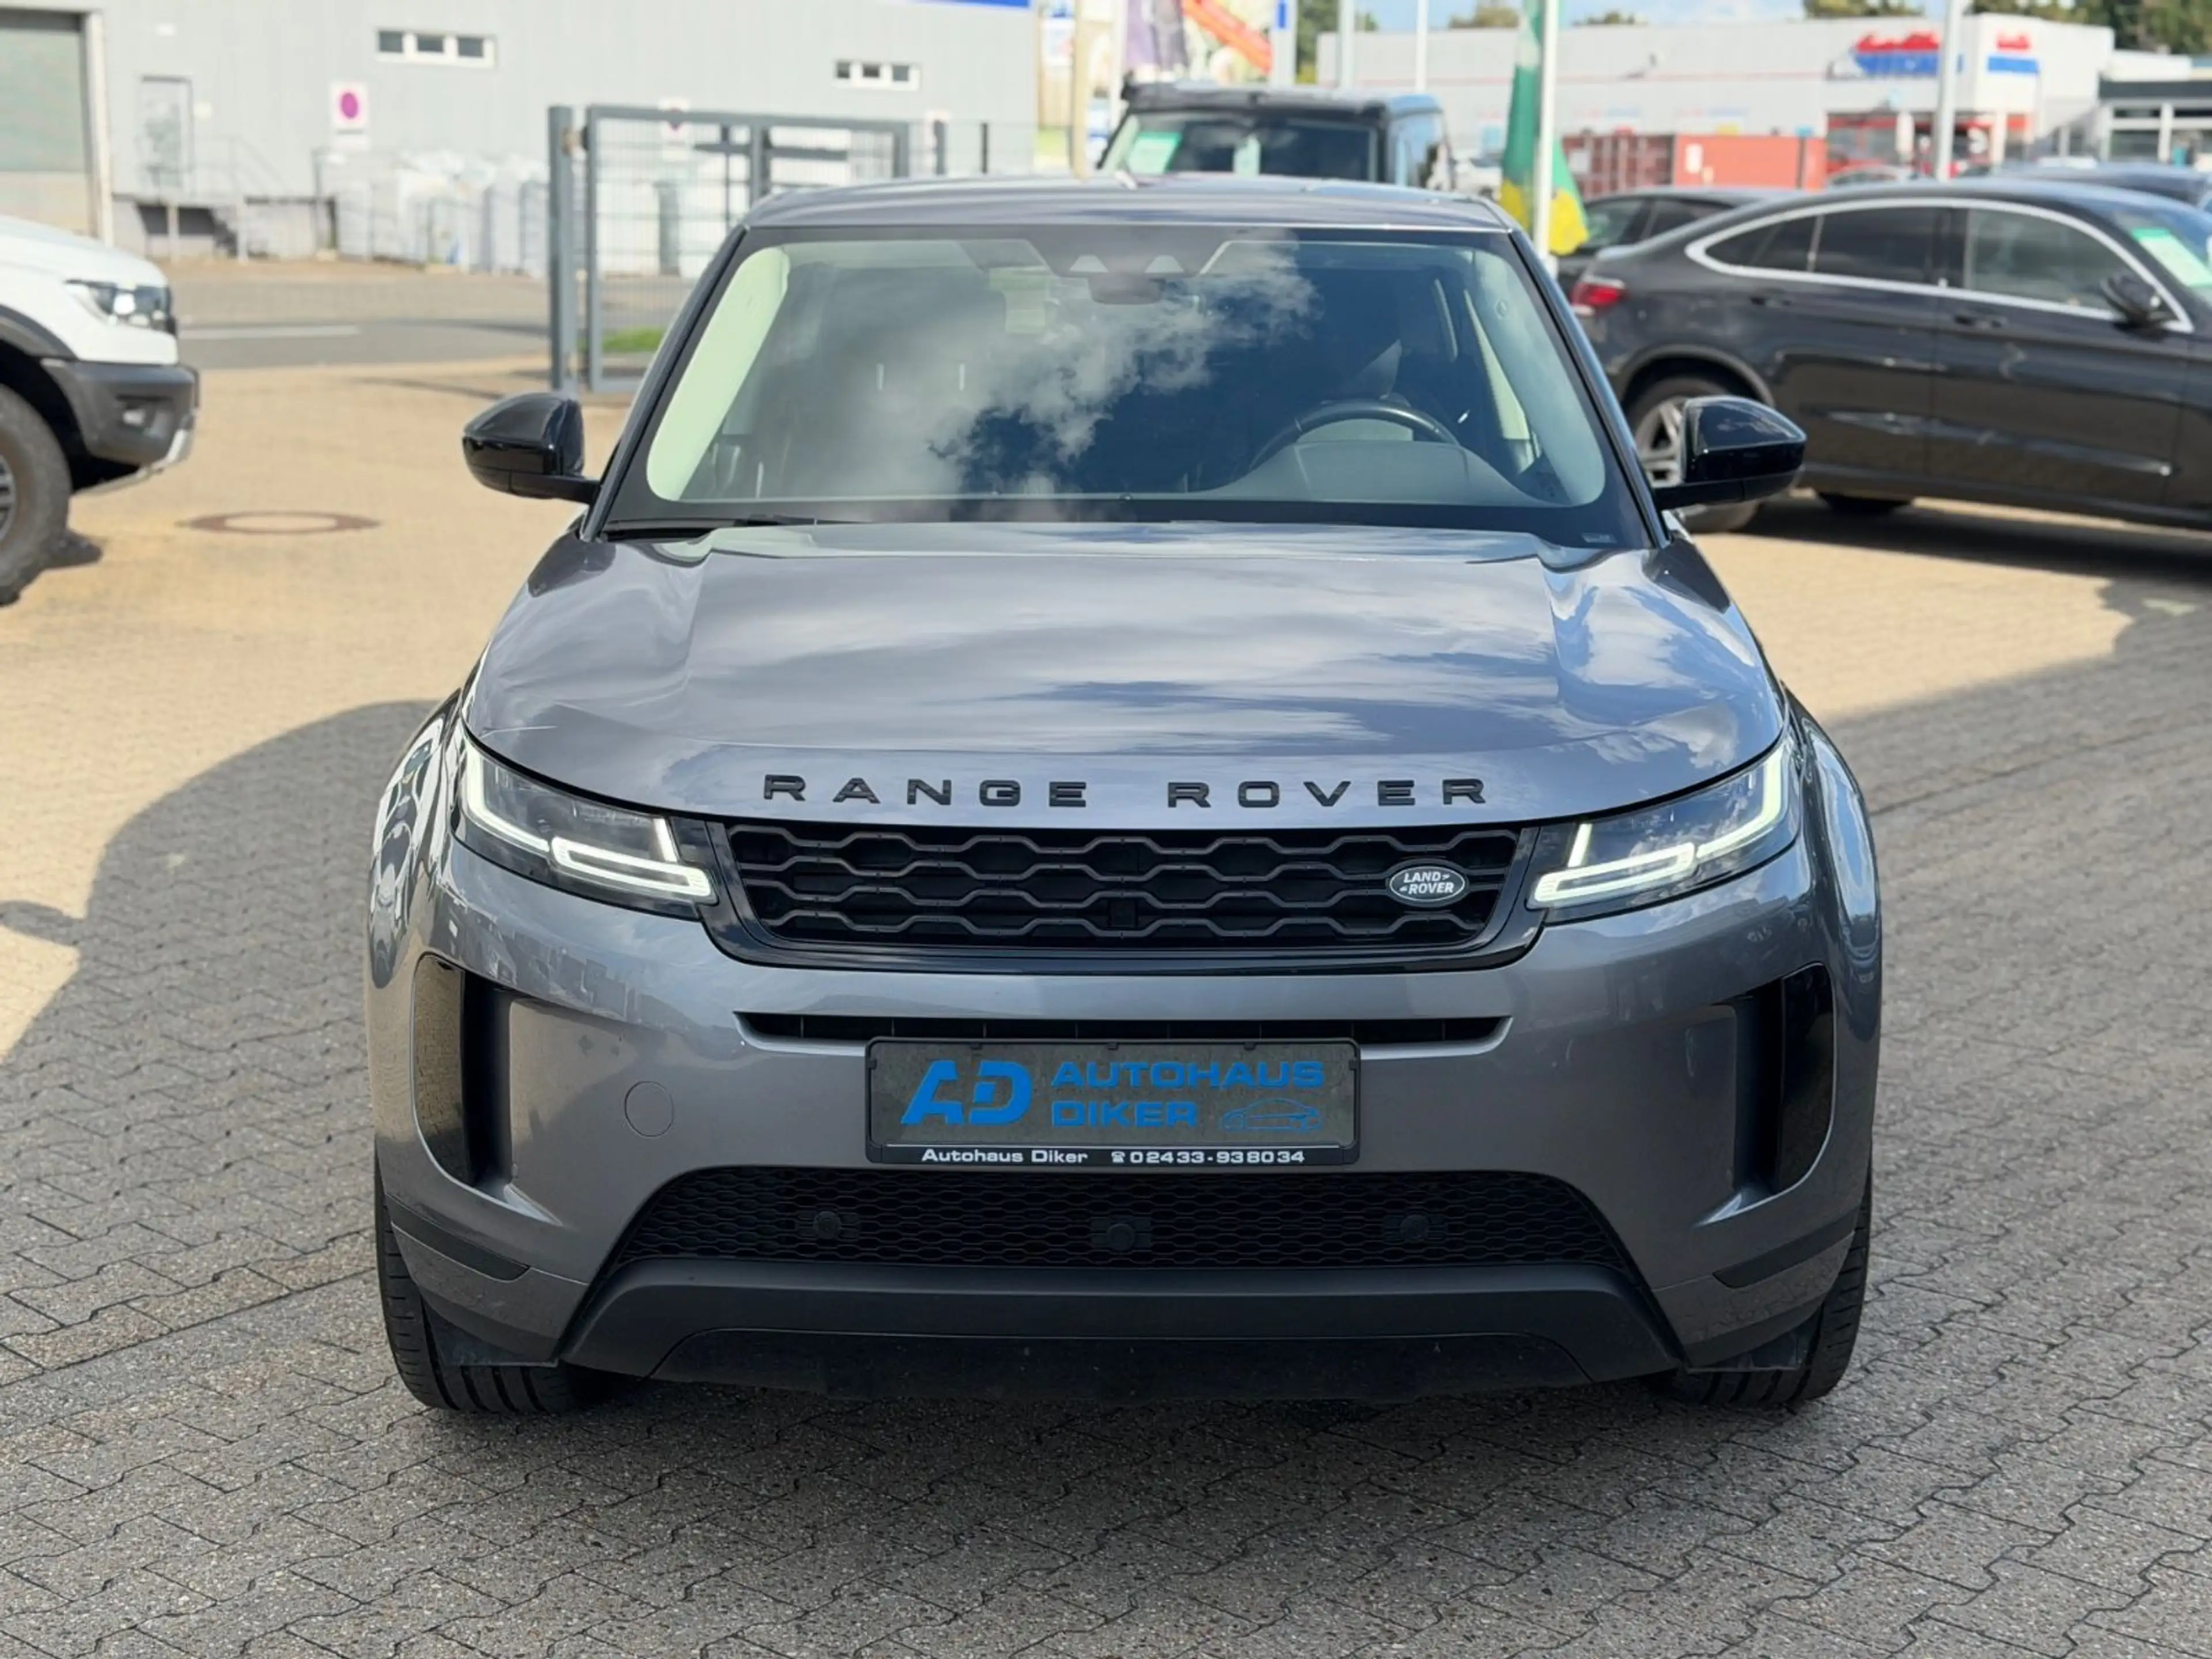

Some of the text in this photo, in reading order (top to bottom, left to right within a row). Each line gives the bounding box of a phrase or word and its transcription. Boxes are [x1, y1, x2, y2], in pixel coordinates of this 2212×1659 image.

[764, 774, 1486, 808] RANGE ROVER
[1403, 871, 1441, 883] LAND
[1408, 881, 1455, 895] ROVER
[1051, 1060, 1325, 1089] AUTOHAUS
[900, 1060, 1032, 1125] AD
[1051, 1101, 1198, 1127] DIKER
[922, 1149, 1305, 1164] Autohaus Diker 02433-938034
